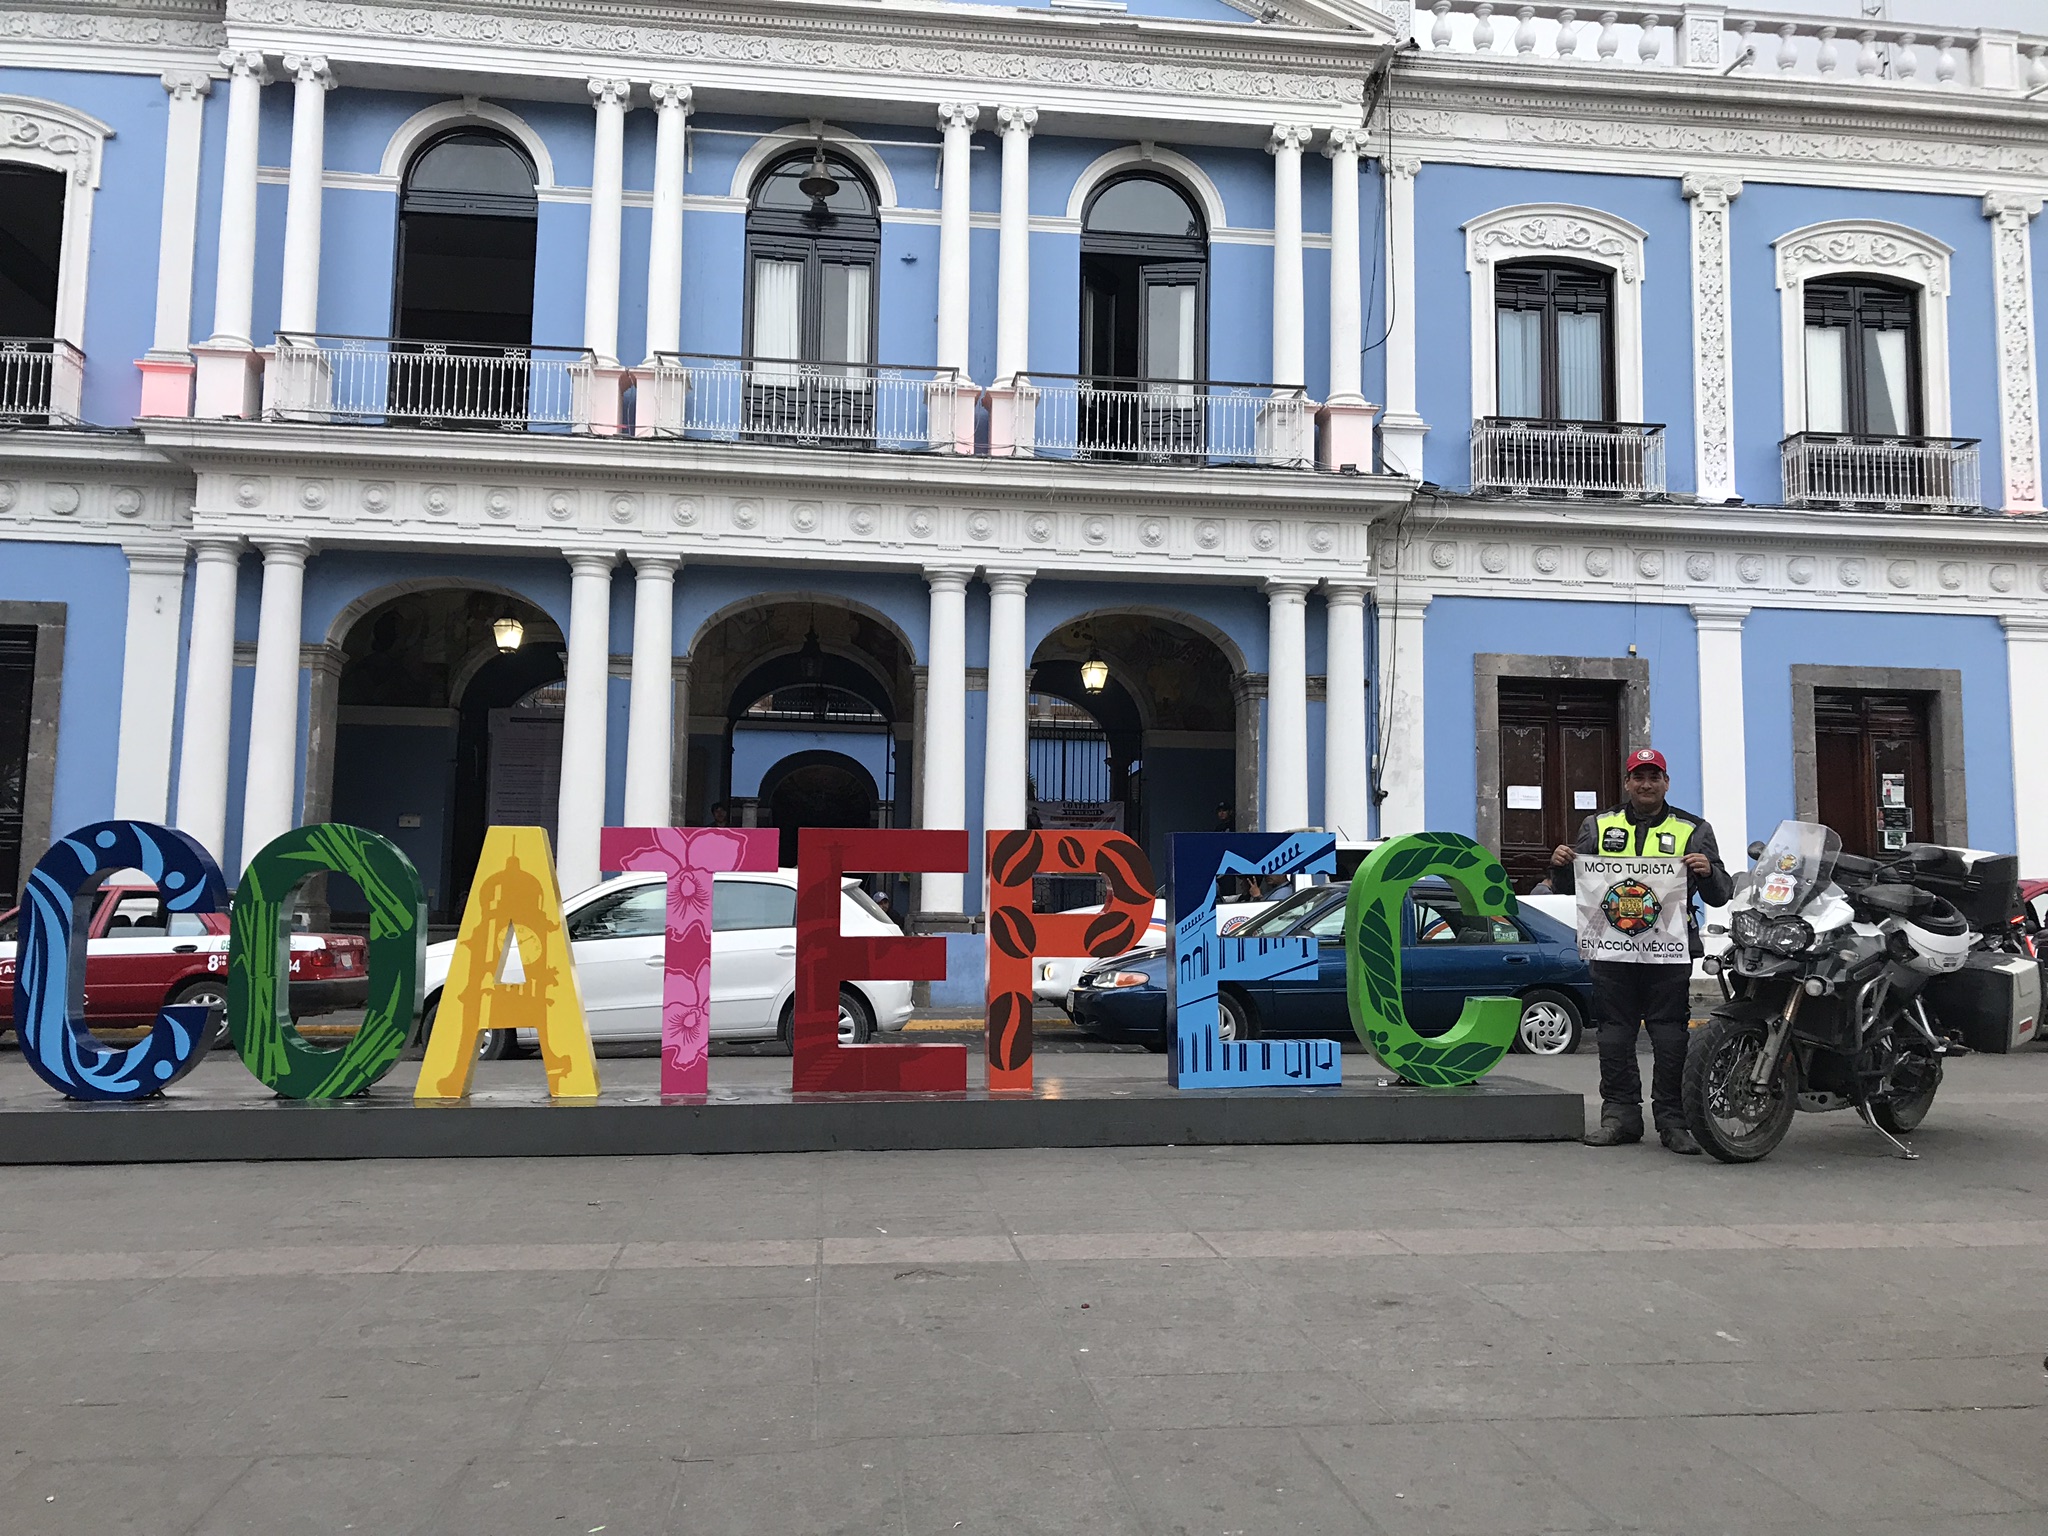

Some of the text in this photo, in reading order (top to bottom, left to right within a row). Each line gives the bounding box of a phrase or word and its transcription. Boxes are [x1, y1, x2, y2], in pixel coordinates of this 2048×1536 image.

[1585, 862, 1675, 875] MOTO TURISTA
[1765, 885, 1790, 901] 227
[1581, 940, 1684, 952] EN ACCIÓN MÉXICO
[13, 820, 1522, 1100] COATEPEC
[207, 954, 219, 971] 8
